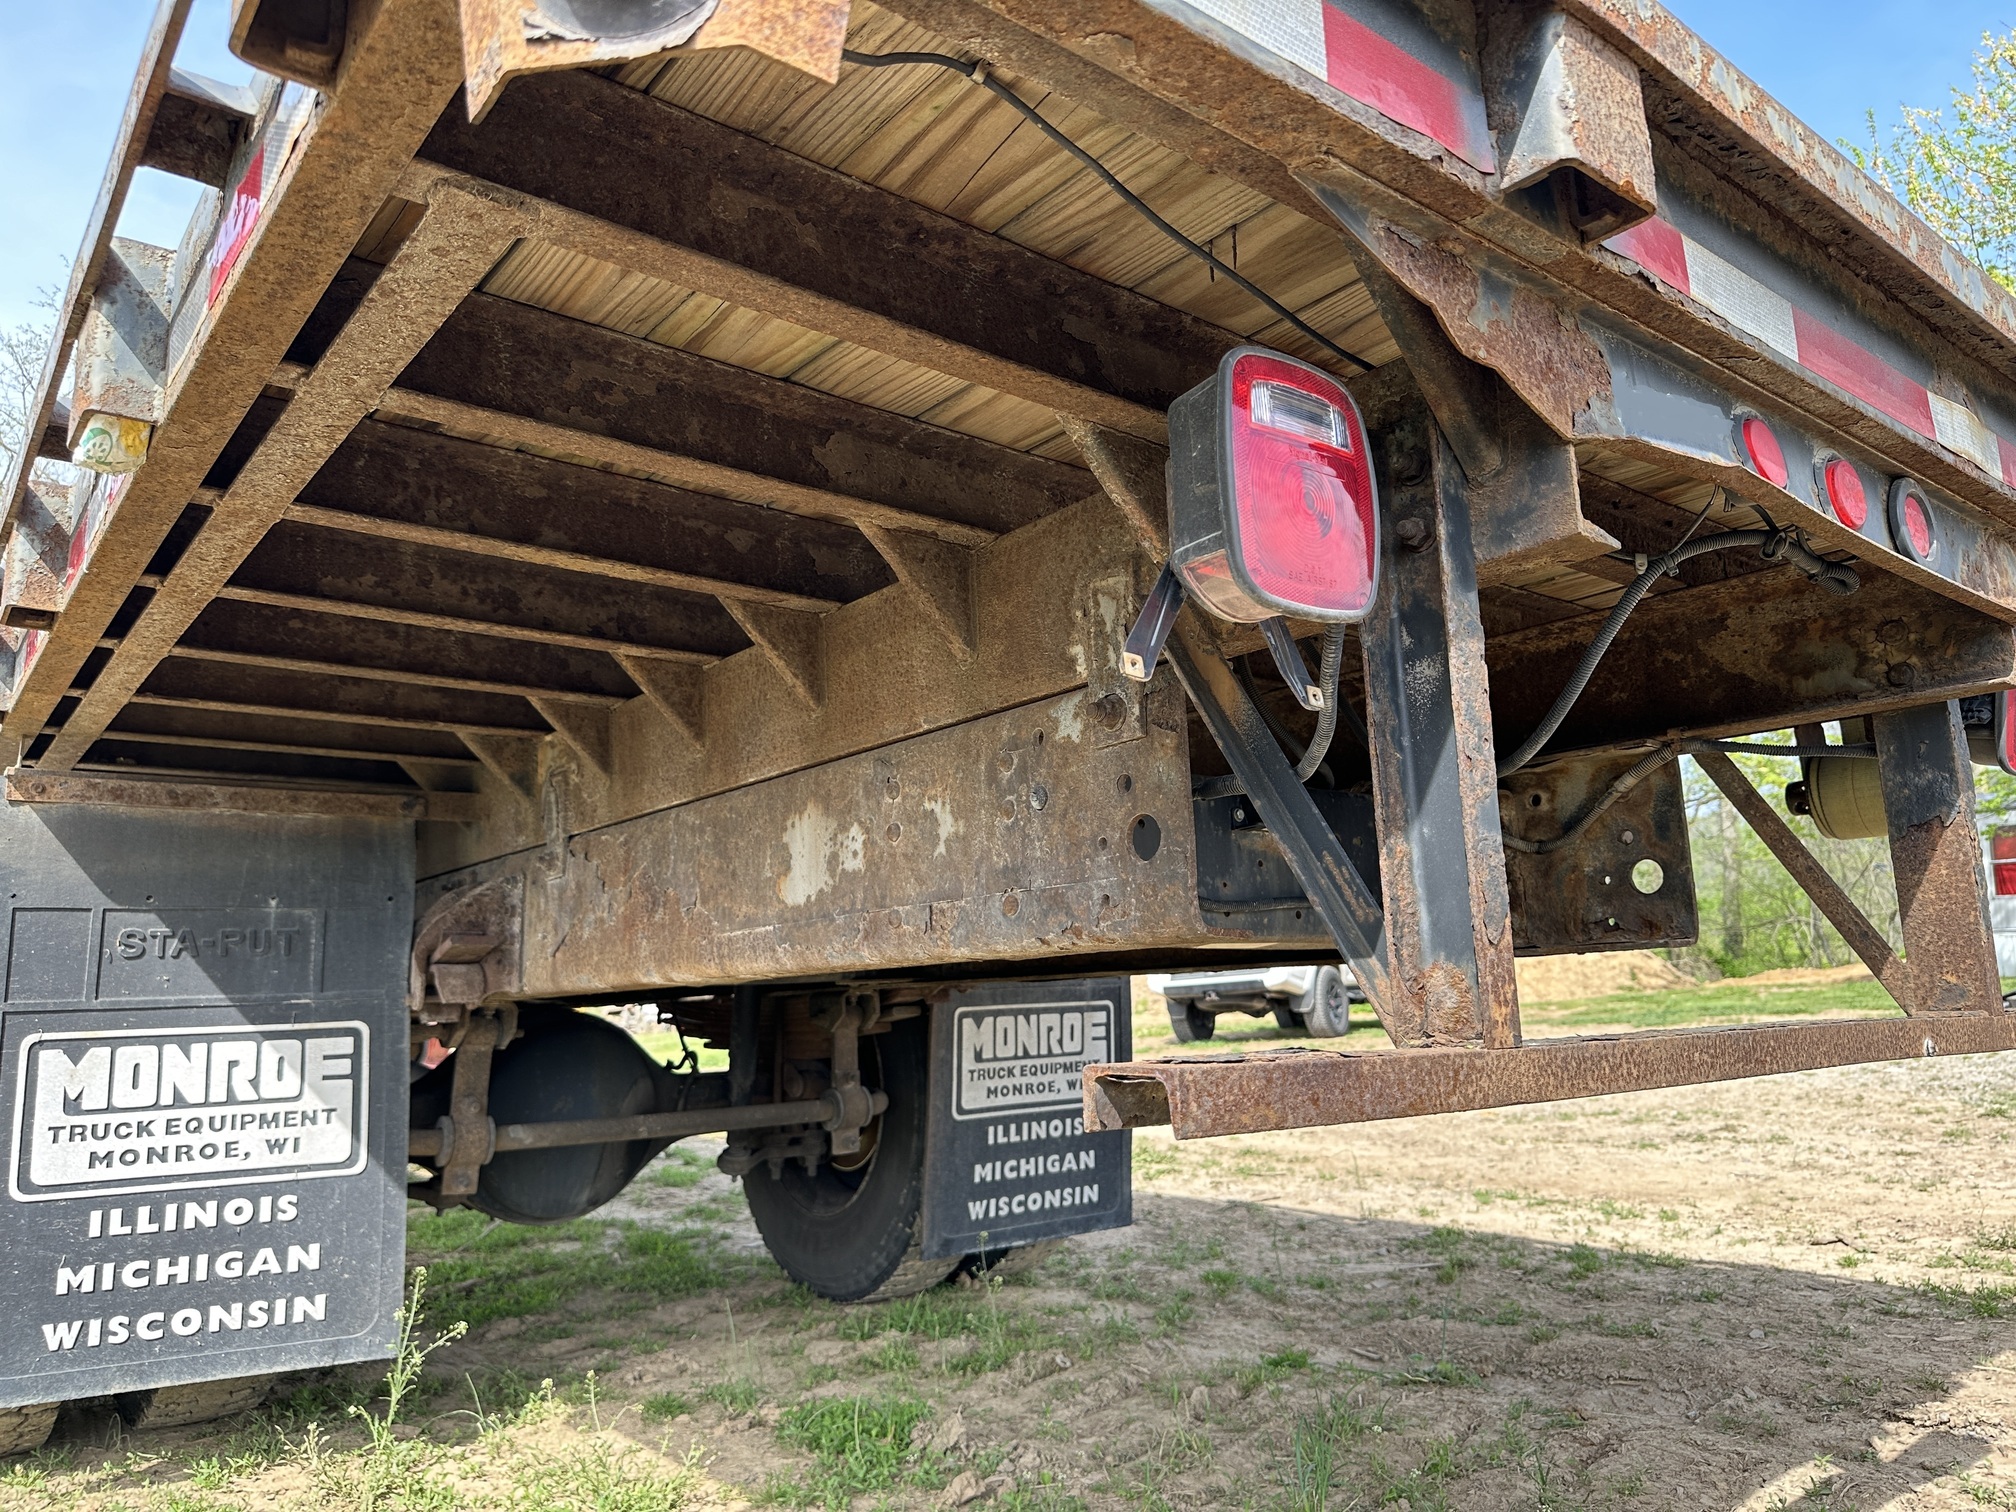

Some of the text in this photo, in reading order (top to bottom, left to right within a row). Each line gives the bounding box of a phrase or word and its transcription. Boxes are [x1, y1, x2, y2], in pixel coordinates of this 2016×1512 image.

[117, 928, 300, 960] STA-PUT
[962, 1011, 1107, 1060] MONROE
[36, 1037, 354, 1111] MONROE
[968, 1064, 1016, 1082] TRUCK
[987, 1081, 1061, 1099] MONROE,
[48, 1108, 338, 1144] TRUCK EQUIPMENT
[987, 1118, 1083, 1145] ILLINOIS
[88, 1136, 302, 1170] MONROE, WI
[973, 1150, 1096, 1184] MICHIGAN
[88, 1194, 298, 1238] ILLINOIS
[968, 1184, 1099, 1221] WISCONSIN
[55, 1243, 322, 1296] MICHIGAN
[42, 1293, 327, 1352] WISCONSIN
